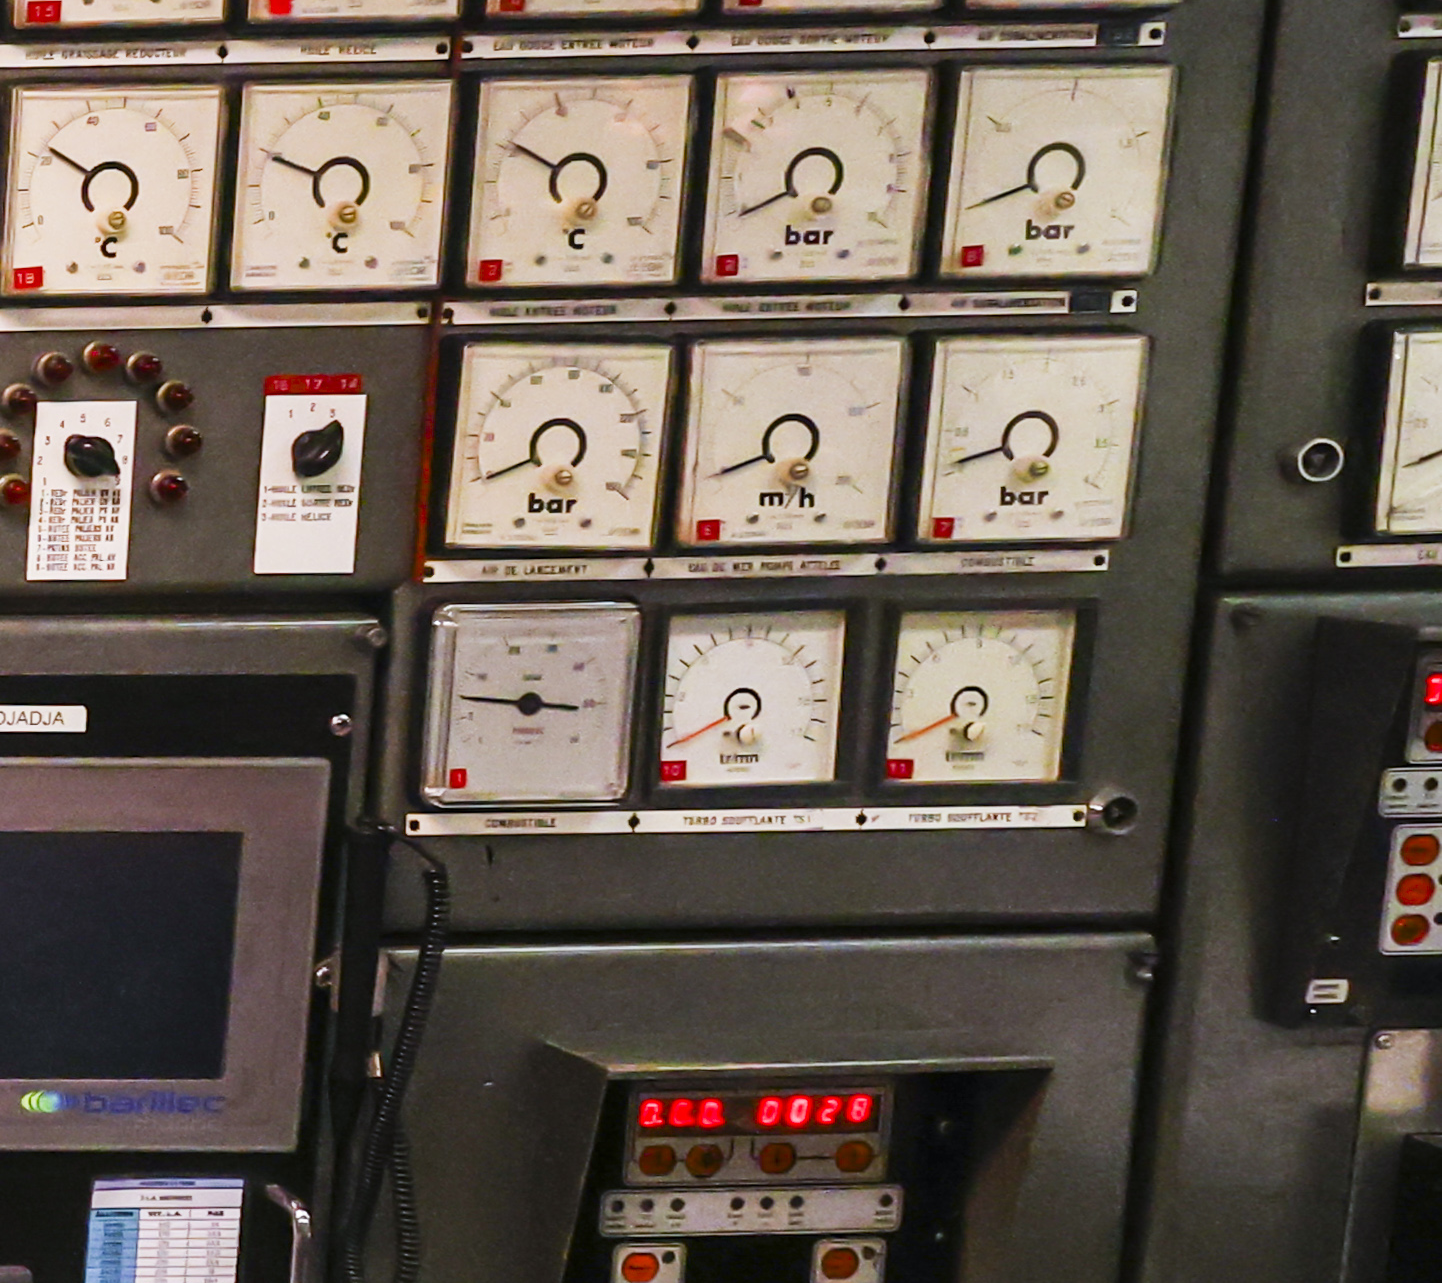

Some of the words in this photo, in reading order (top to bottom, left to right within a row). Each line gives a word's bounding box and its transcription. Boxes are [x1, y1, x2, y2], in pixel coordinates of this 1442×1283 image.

[784, 225, 834, 246] bar
[1024, 219, 1075, 240] bar
[94, 236, 118, 259] °C
[527, 492, 578, 514] bar
[1000, 485, 1049, 506] bar
[759, 1096, 870, 1125] 0028
